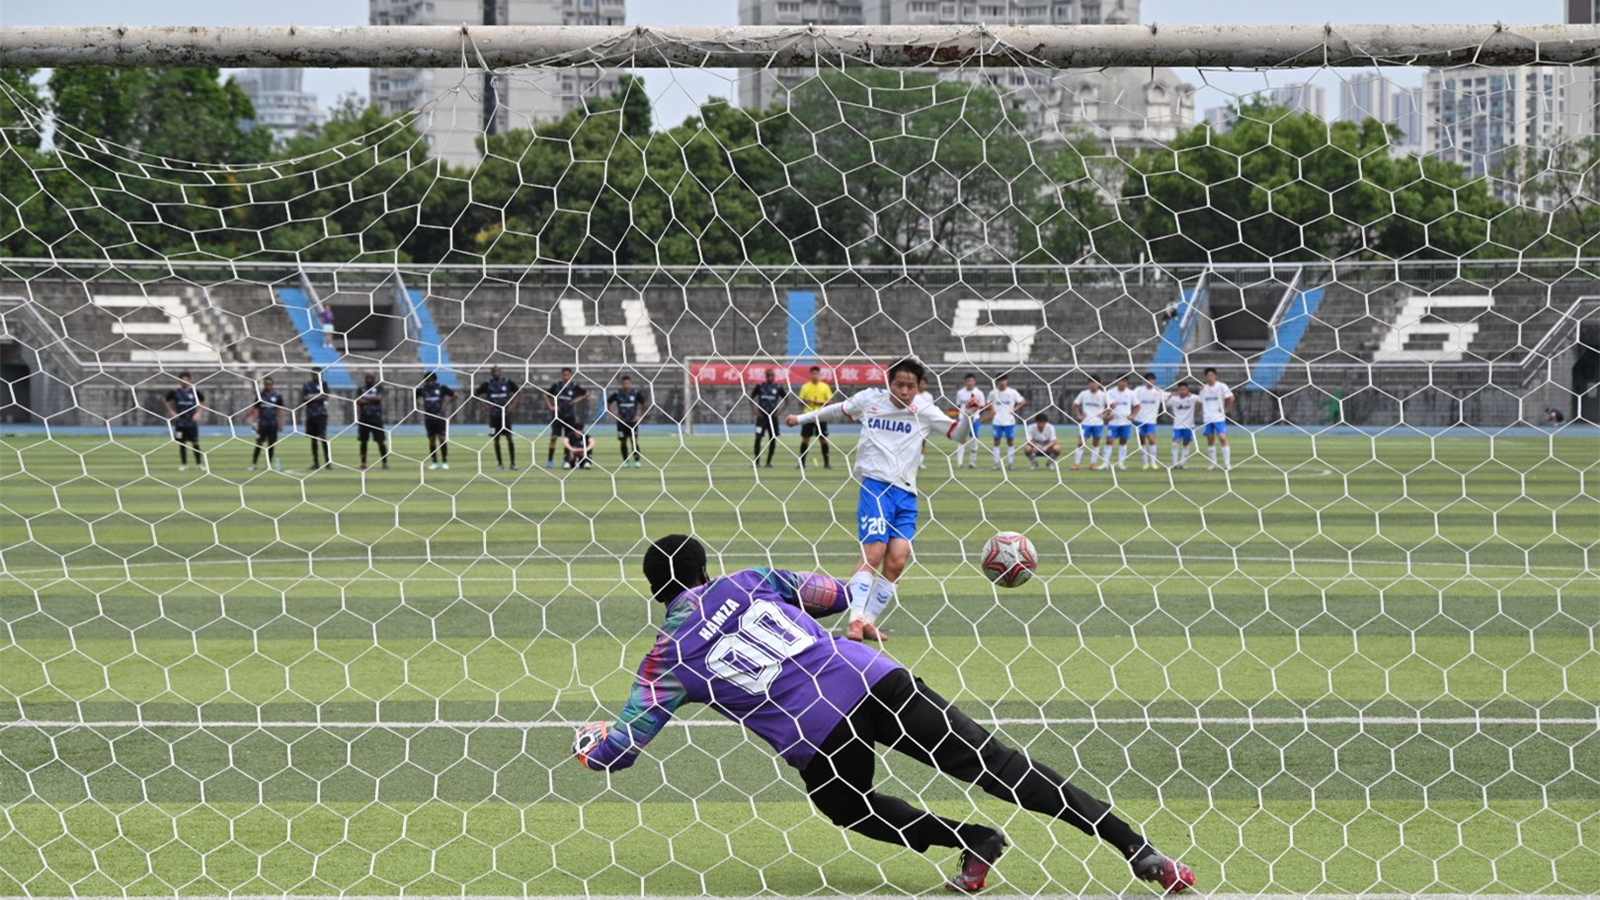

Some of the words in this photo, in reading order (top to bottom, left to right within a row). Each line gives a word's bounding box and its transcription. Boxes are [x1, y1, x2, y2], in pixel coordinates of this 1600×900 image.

[94, 295, 220, 362] 3
[560, 299, 661, 363] 4
[943, 299, 1044, 363] 5
[1372, 295, 1495, 362] 6
[868, 418, 912, 434] CAILIAO
[867, 516, 888, 535] 20
[699, 598, 740, 641] HAMZA
[705, 598, 818, 695] 00
